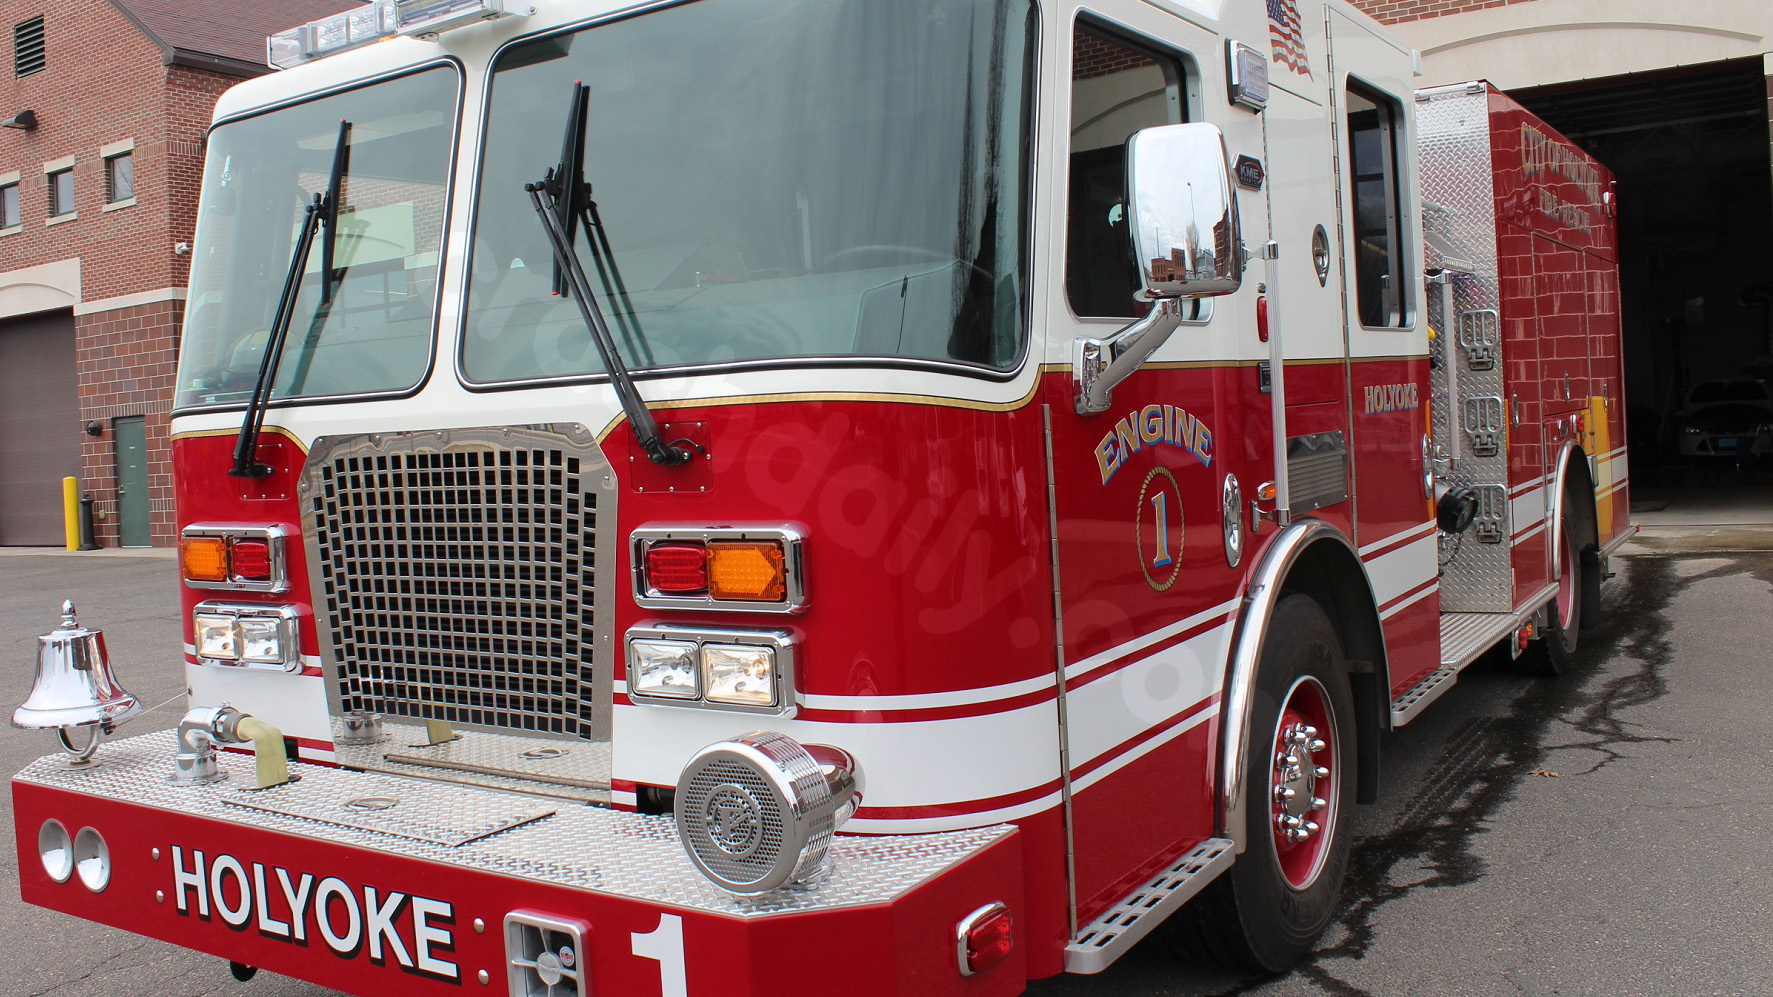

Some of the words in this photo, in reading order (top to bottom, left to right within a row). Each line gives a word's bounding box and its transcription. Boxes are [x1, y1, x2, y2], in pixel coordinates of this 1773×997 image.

[1240, 164, 1259, 179] KME
[1521, 121, 1546, 178] CITY
[1548, 138, 1562, 174] OF
[1364, 382, 1419, 415] HOLYOKE
[1094, 404, 1213, 486] ENGINE
[1151, 491, 1172, 567] 1
[170, 845, 461, 984] HOLYOKE
[631, 913, 687, 997] 1
